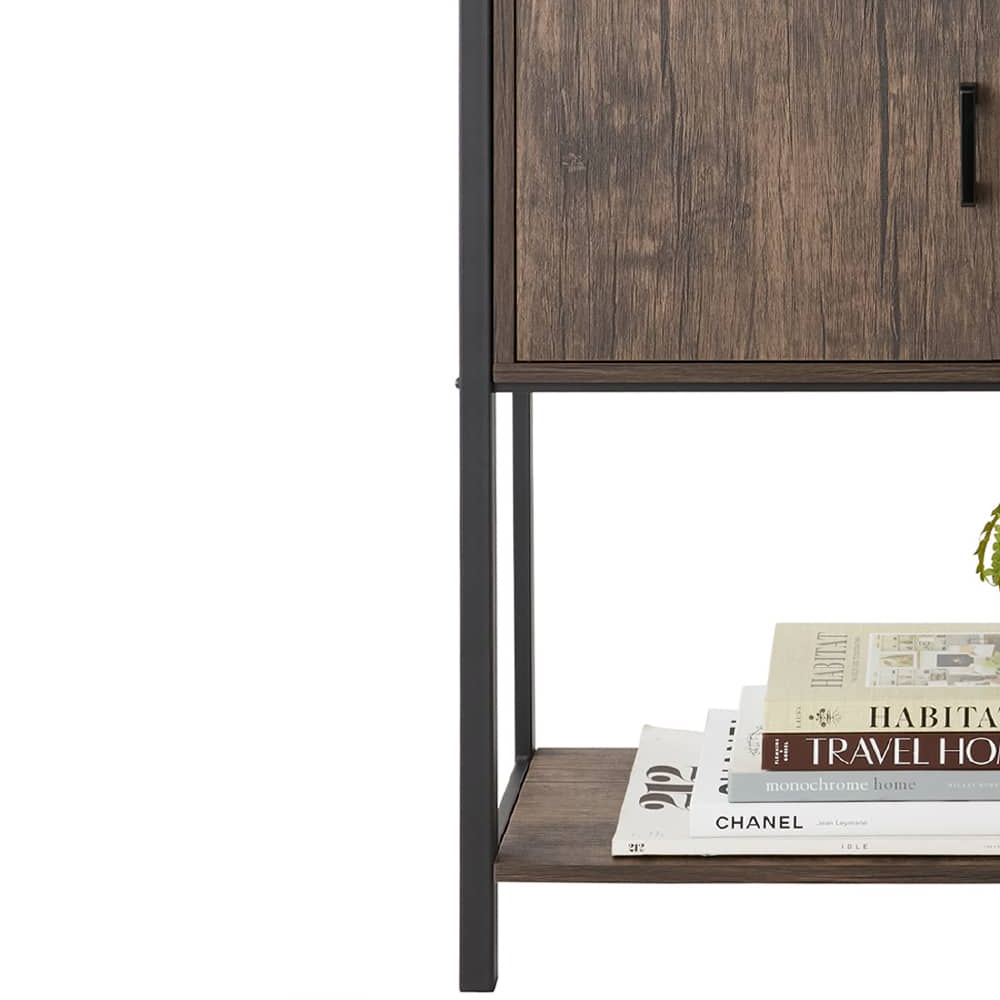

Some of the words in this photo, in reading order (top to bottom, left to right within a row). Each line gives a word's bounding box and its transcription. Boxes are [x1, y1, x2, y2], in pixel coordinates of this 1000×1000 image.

[810, 631, 849, 688] HABITAT
[805, 736, 930, 765] TRAVEL
[638, 764, 699, 812] 212
[765, 777, 870, 792] monochrome
[872, 776, 918, 791] home
[715, 815, 804, 830] CHANEL
